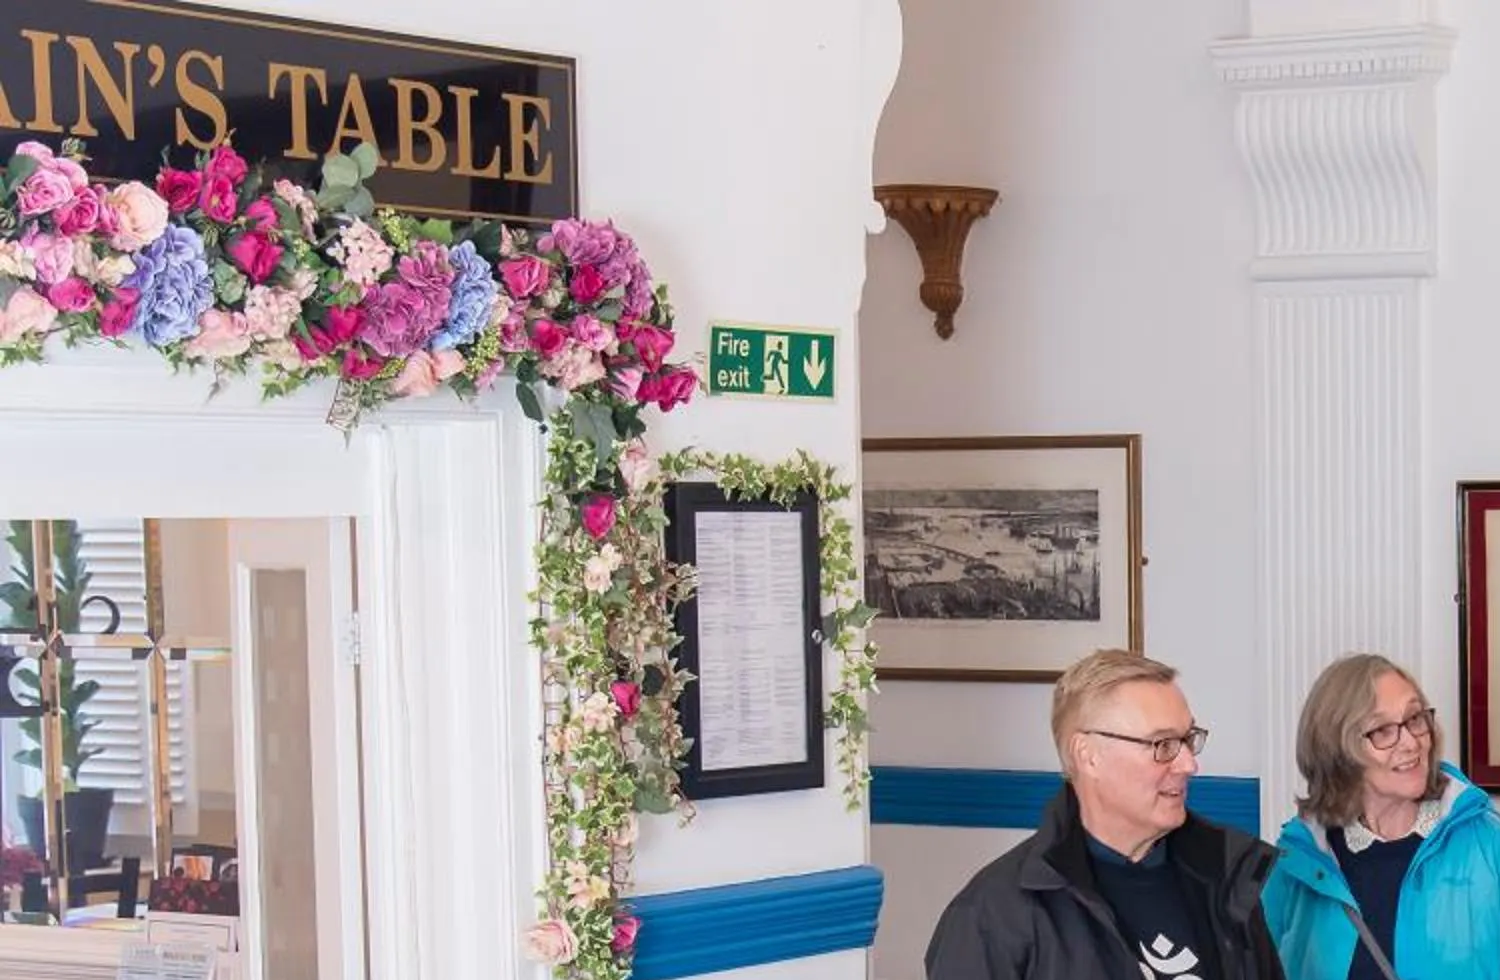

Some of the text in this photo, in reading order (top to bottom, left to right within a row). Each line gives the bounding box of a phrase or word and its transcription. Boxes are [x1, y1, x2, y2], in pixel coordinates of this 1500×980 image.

[0, 28, 553, 184] IN'S TABLE
[717, 331, 750, 357] Fire
[717, 366, 751, 388] exit
